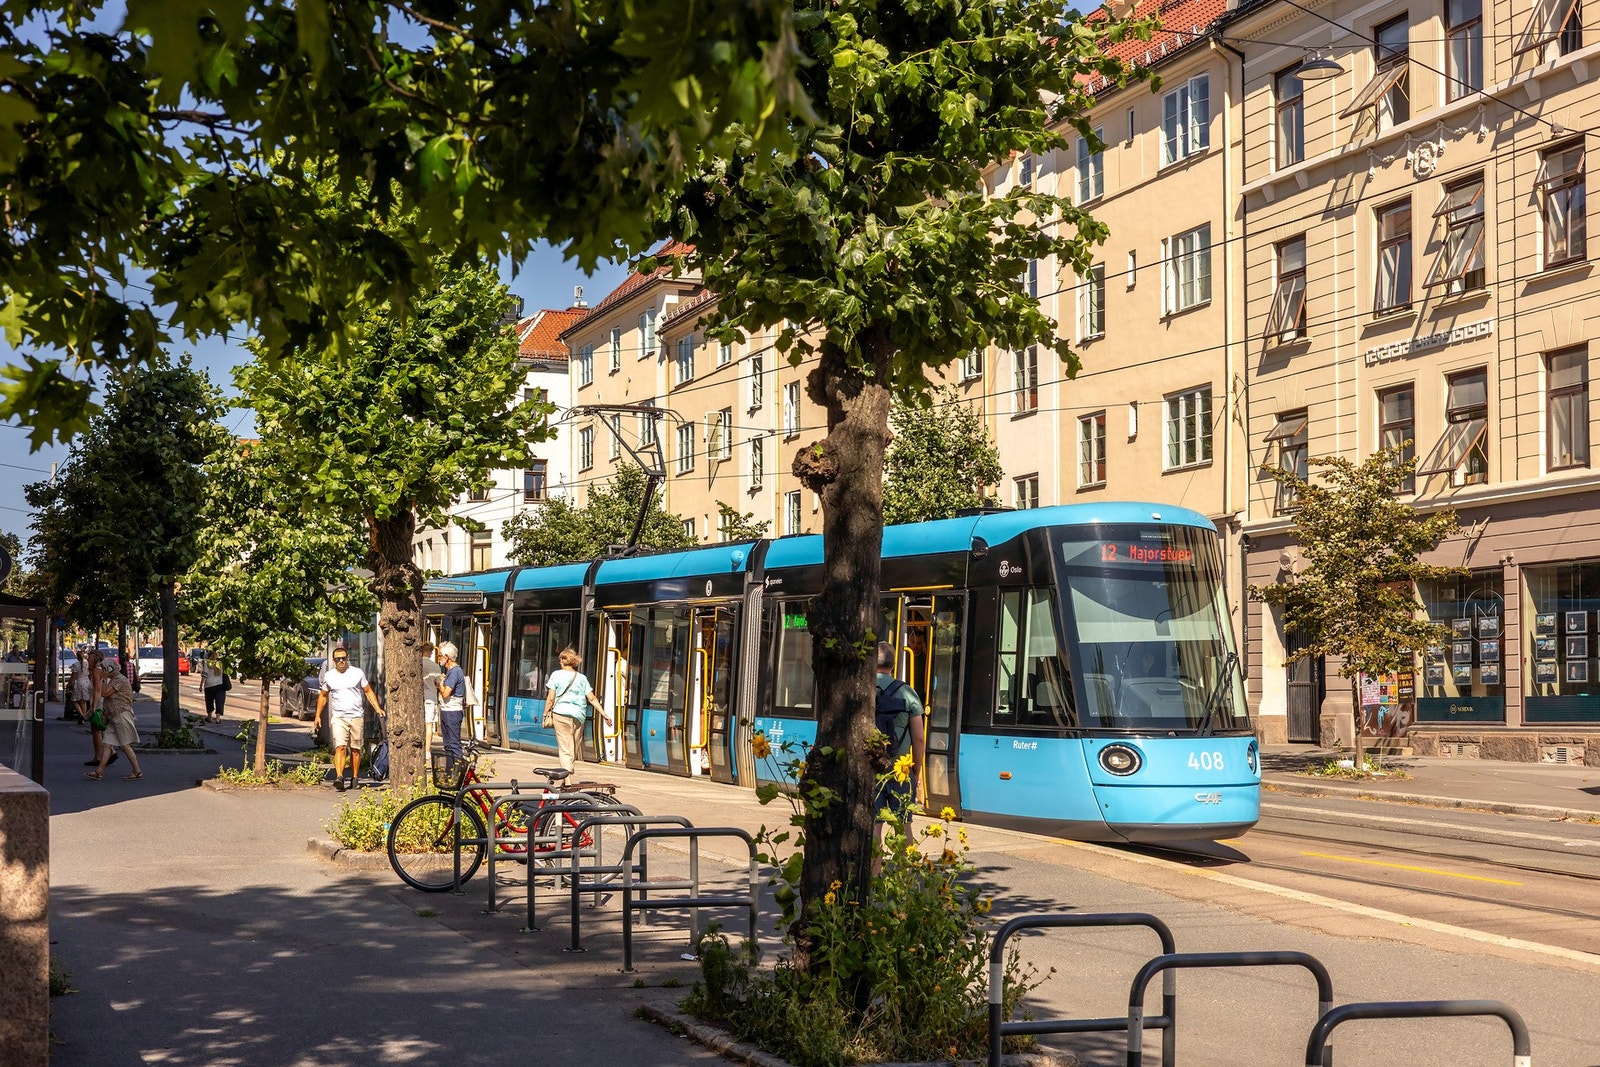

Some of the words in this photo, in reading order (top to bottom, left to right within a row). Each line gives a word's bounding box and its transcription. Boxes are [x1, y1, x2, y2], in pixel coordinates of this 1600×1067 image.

[1101, 543, 1117, 561] 12
[1129, 544, 1193, 563] Majorstuen
[1012, 740, 1038, 750] Ruter#
[1187, 751, 1225, 771] 408
